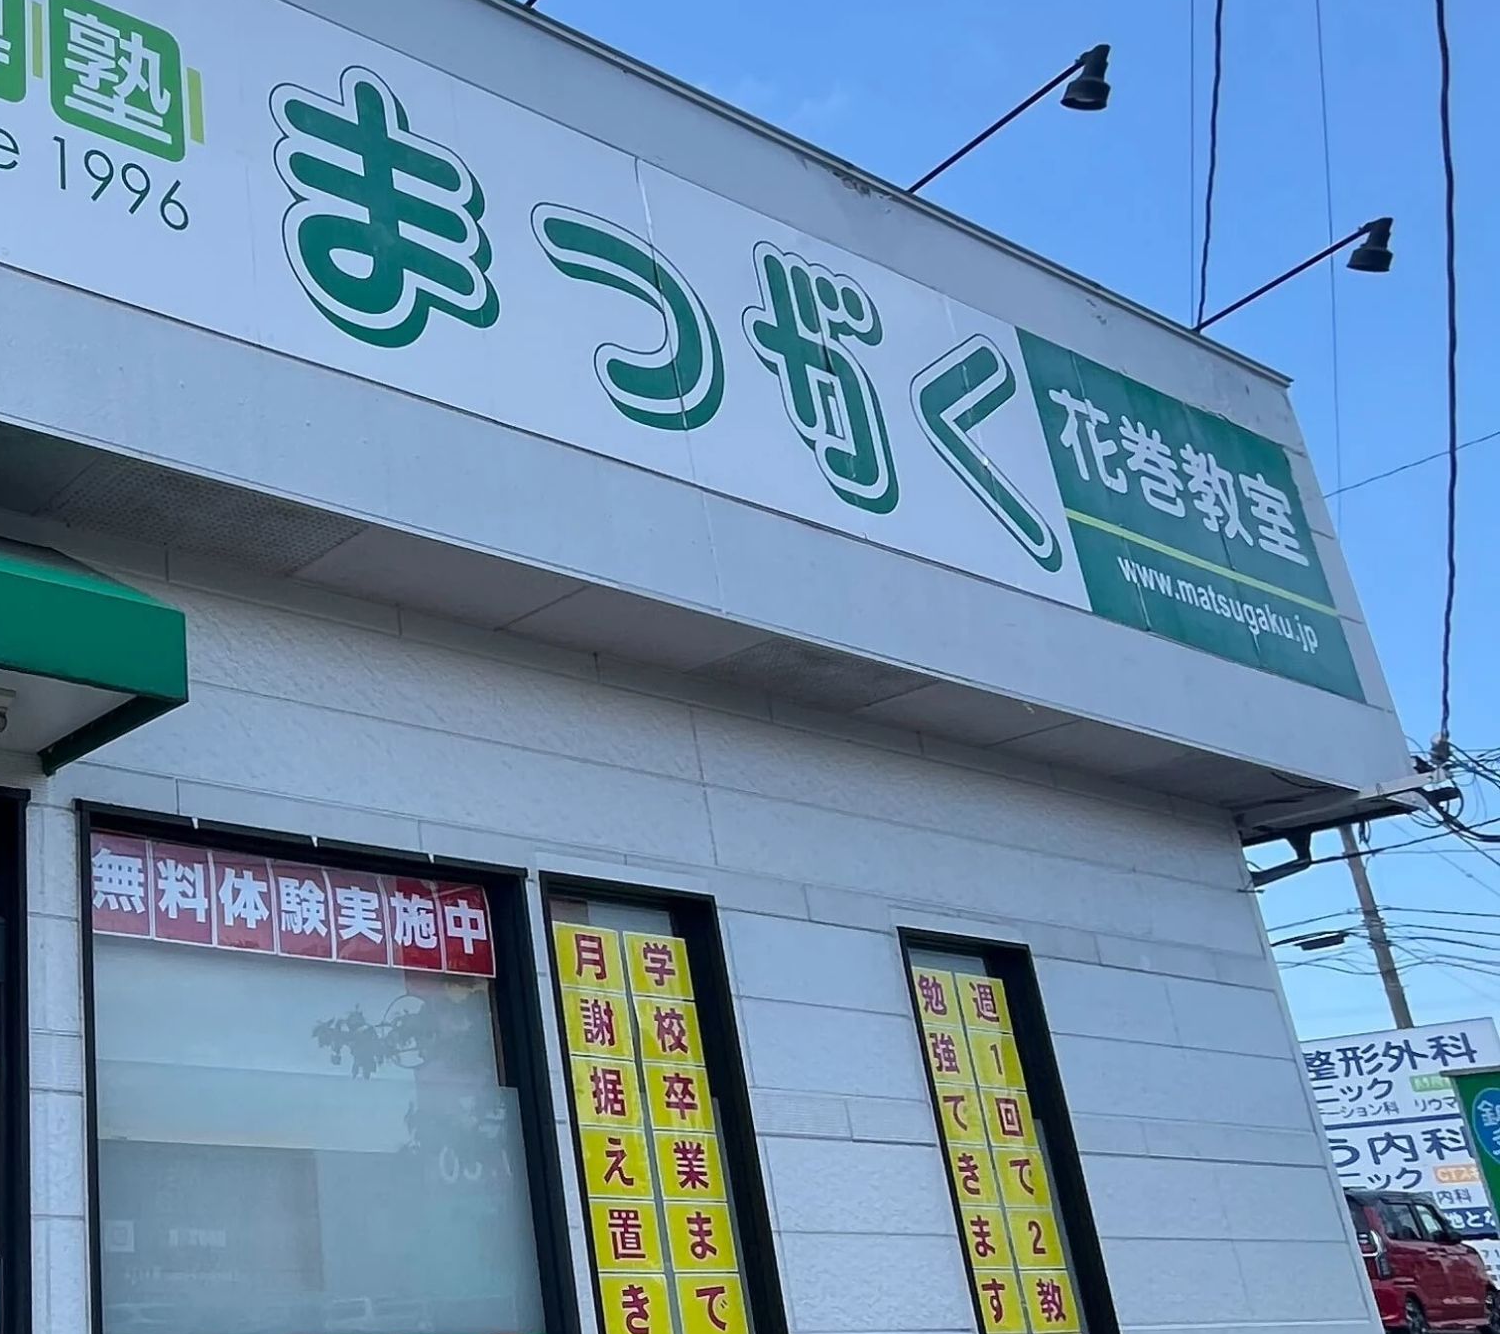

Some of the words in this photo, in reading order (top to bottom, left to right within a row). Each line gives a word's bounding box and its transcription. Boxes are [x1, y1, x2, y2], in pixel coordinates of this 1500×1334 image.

[51, 135, 190, 232] 1996
[268, 65, 1062, 573] まつがく
[1048, 388, 1310, 568] 花巻教室
[1117, 555, 1319, 655] www.matsugaku.jp
[91, 847, 488, 955] 無料体験実施中
[1303, 1032, 1478, 1081] 整形外科
[642, 941, 728, 1331] 学校卒業まで
